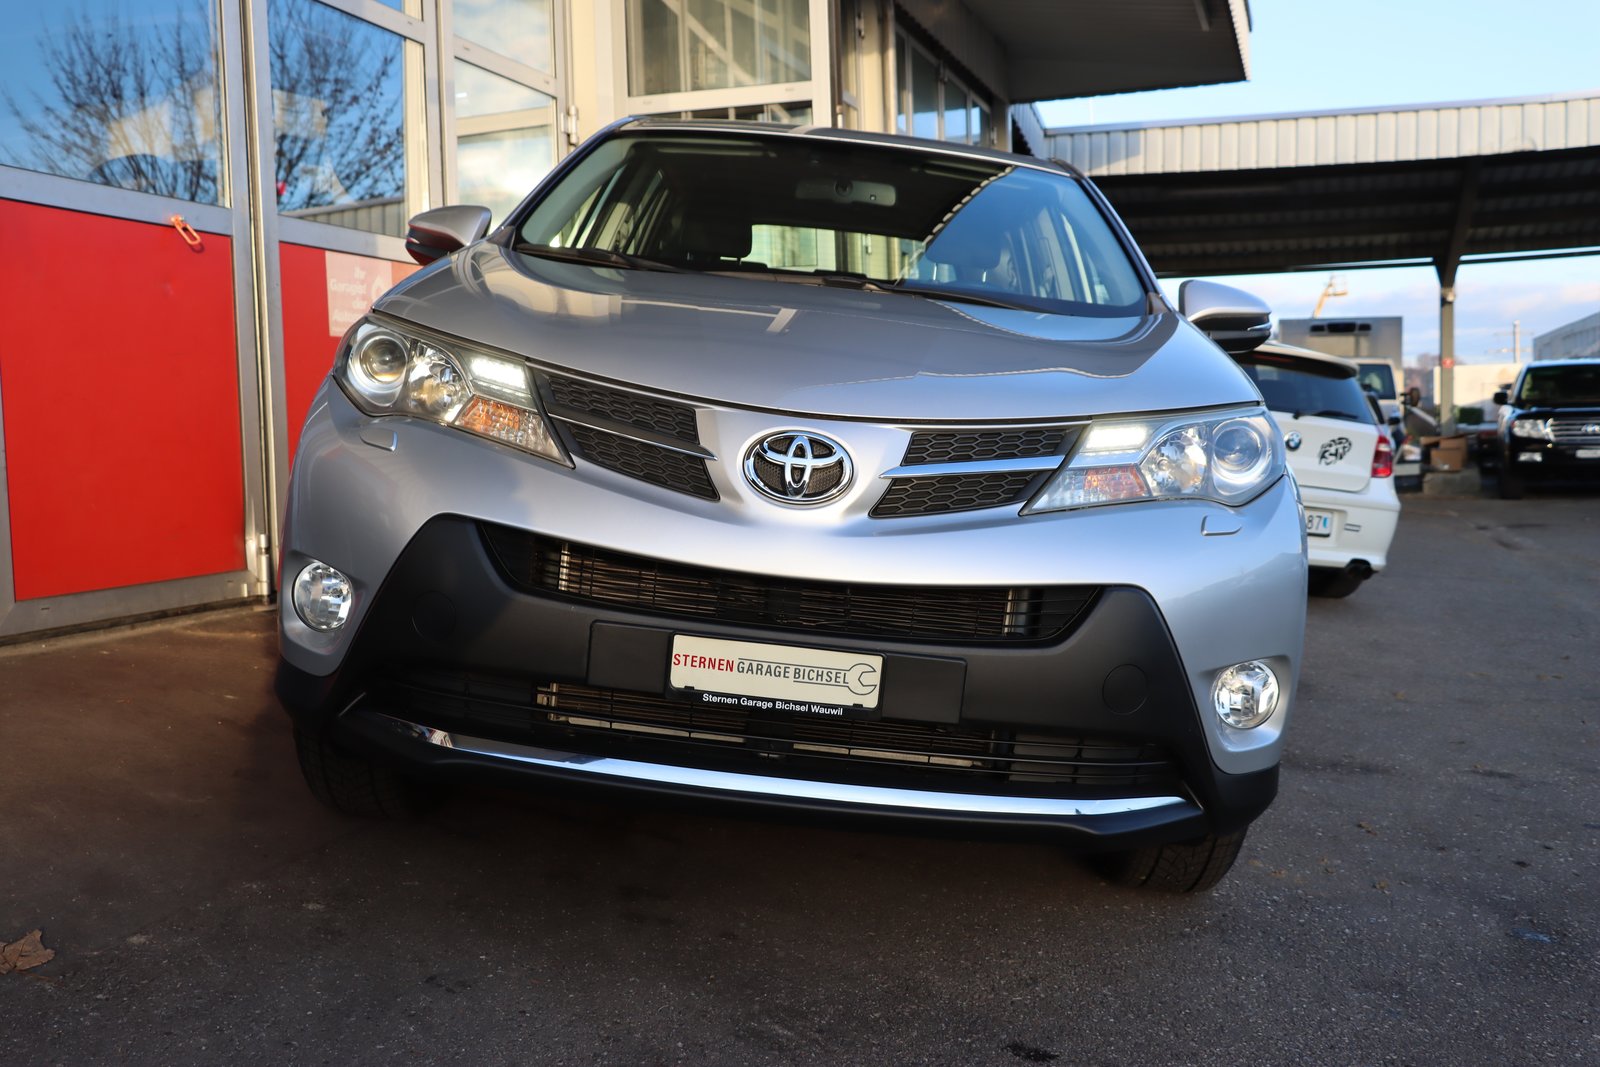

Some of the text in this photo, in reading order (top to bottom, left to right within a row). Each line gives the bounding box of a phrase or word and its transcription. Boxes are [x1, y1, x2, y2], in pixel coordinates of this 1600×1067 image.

[673, 653, 849, 684] STERNEN GARAGE BICHSEL
[702, 693, 843, 715] Sternen Garage Bichsel Wauwil
